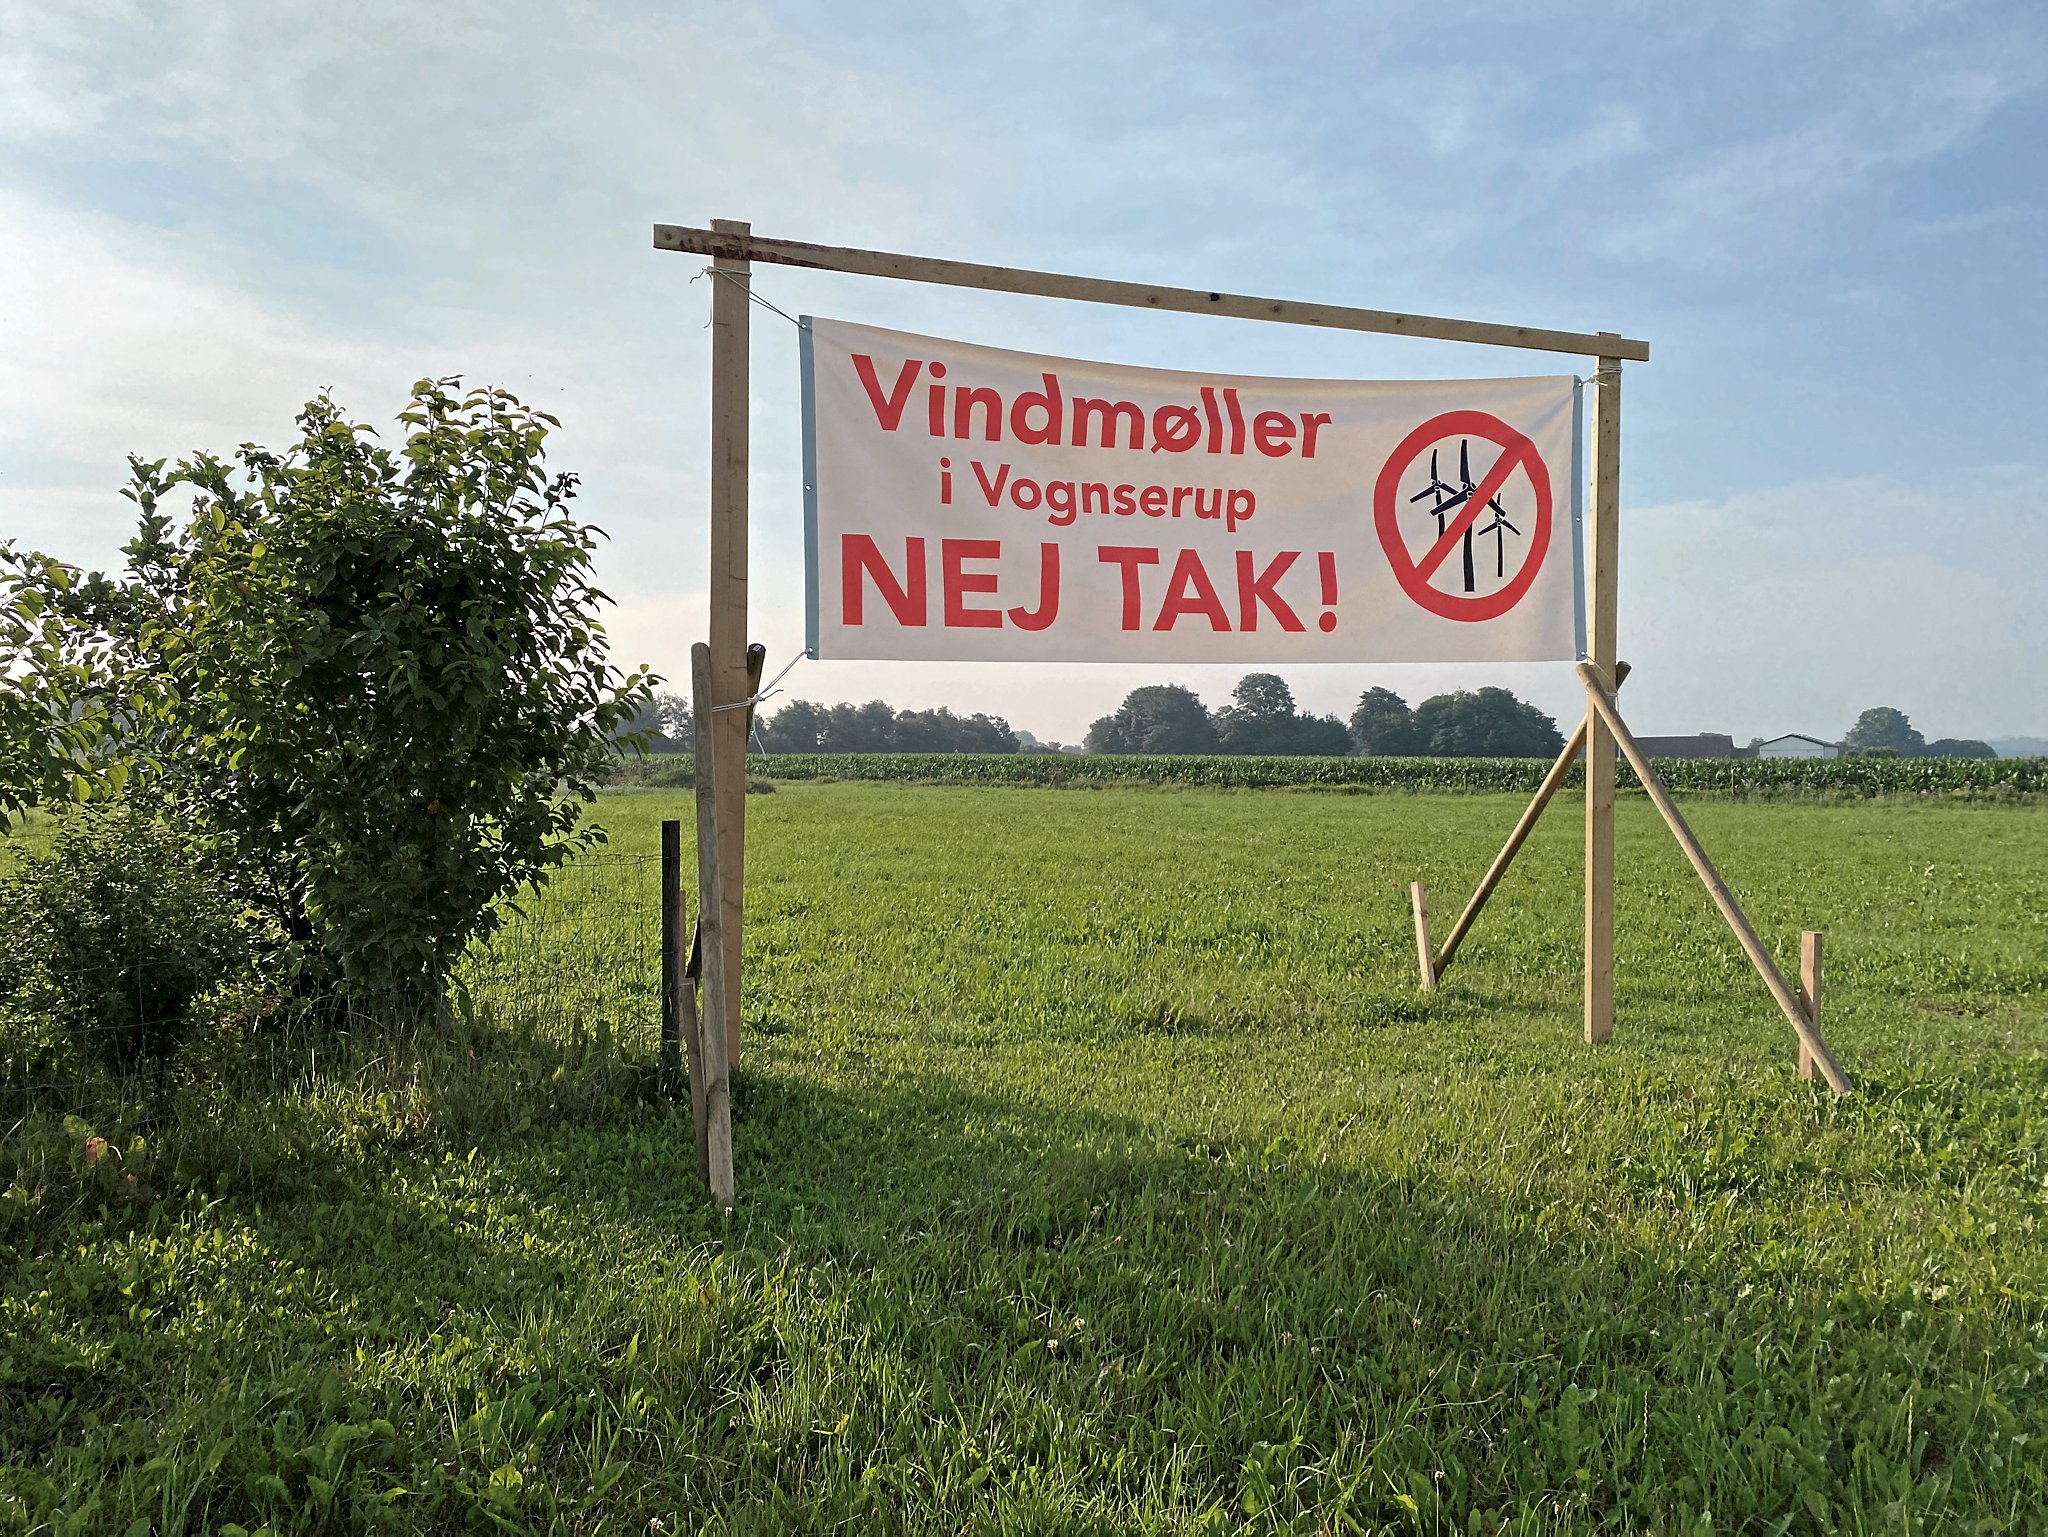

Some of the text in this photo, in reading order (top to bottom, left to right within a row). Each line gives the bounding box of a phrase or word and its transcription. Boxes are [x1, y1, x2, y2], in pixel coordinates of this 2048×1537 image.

[851, 353, 1332, 459] Vindmøller
[940, 457, 1257, 534] i Vognserup
[841, 533, 1338, 634] NEJ TAK!
